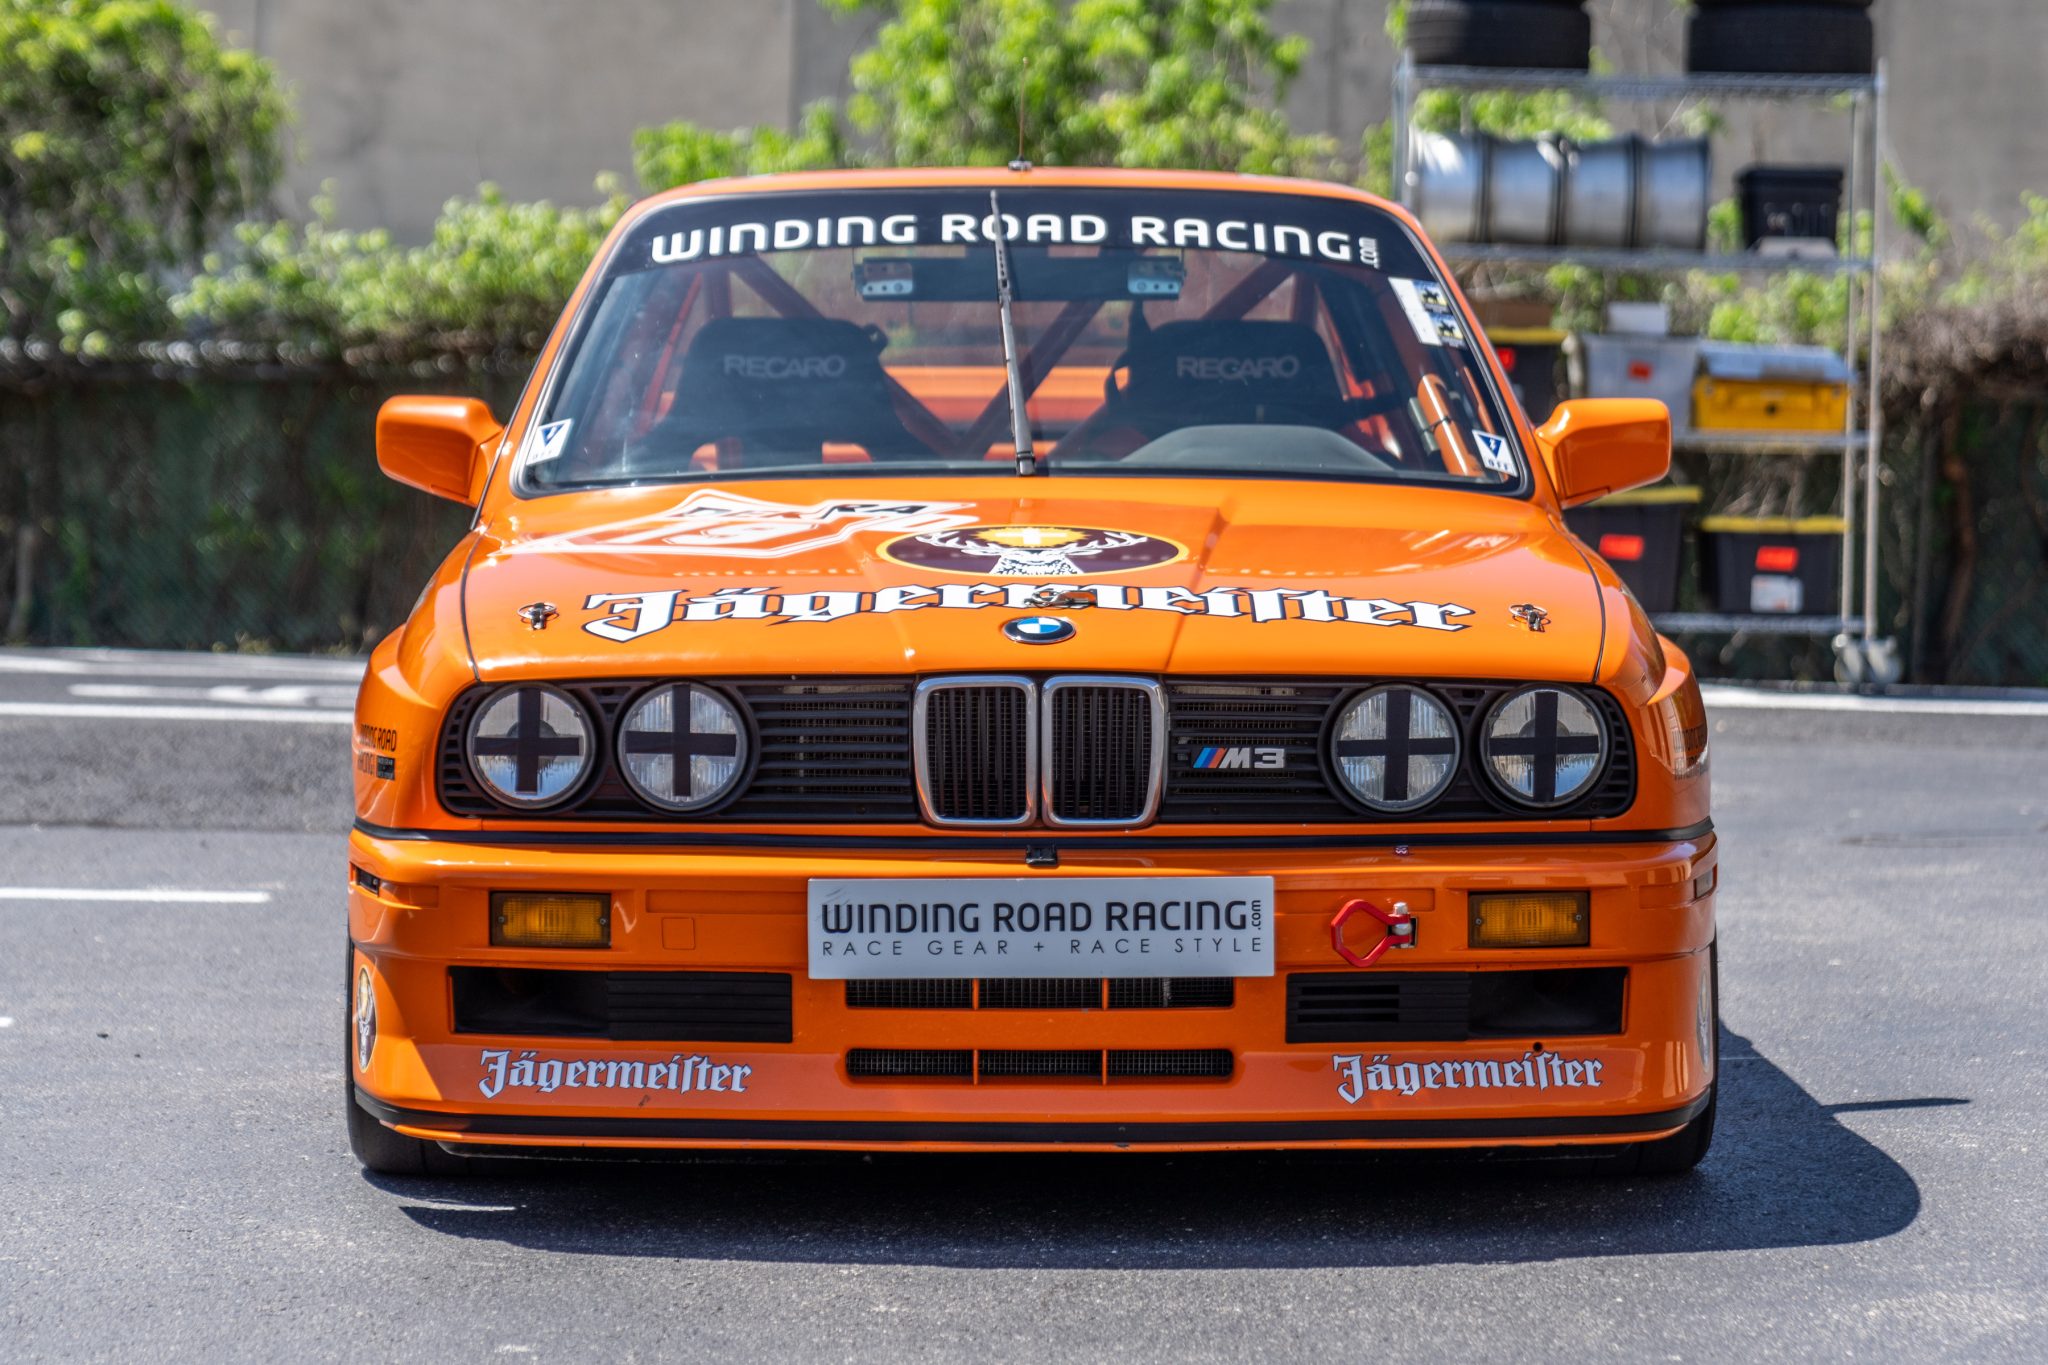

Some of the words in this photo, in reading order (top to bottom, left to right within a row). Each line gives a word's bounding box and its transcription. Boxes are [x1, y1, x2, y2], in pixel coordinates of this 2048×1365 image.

[651, 214, 918, 263] WINDING
[941, 214, 1107, 243] ROAD
[1131, 216, 1352, 261] RACING
[723, 354, 847, 378] RECARO
[1176, 354, 1300, 379] RECARO
[1218, 747, 1285, 769] M3
[821, 903, 980, 934] WINDING
[993, 901, 1092, 933] ROAD
[1105, 900, 1247, 931] RACING
[1251, 899, 1261, 930] .com
[822, 941, 903, 956] RACE
[927, 940, 1008, 955] GEAR
[1070, 939, 1151, 954] RACE
[1174, 937, 1261, 953] STYLE
